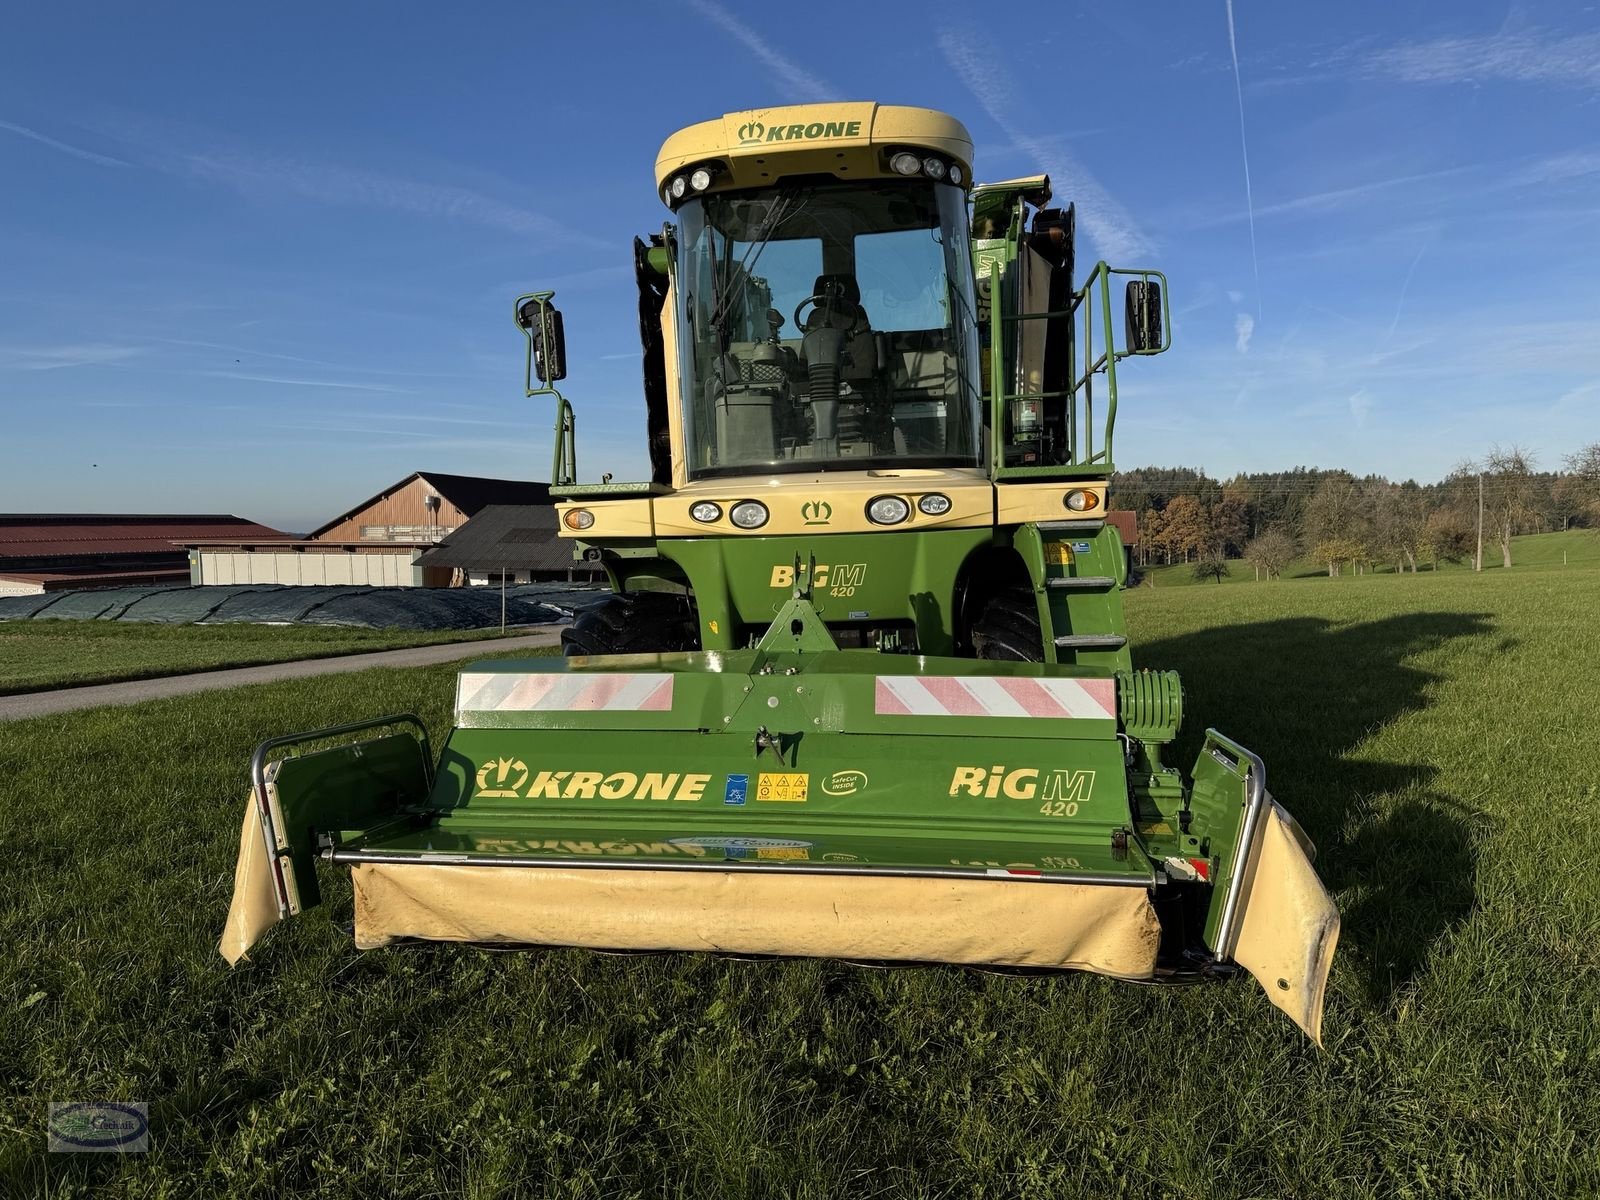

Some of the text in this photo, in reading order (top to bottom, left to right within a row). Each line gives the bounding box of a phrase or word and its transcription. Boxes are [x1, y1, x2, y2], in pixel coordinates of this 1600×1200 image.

[766, 121, 861, 142] KRONE
[831, 563, 867, 587] M
[830, 587, 855, 598] 420
[525, 771, 713, 801] KRONE
[832, 776, 858, 784] SafeCut
[832, 782, 855, 790] INSIDE
[1042, 769, 1096, 801] M
[1040, 801, 1079, 817] 420
